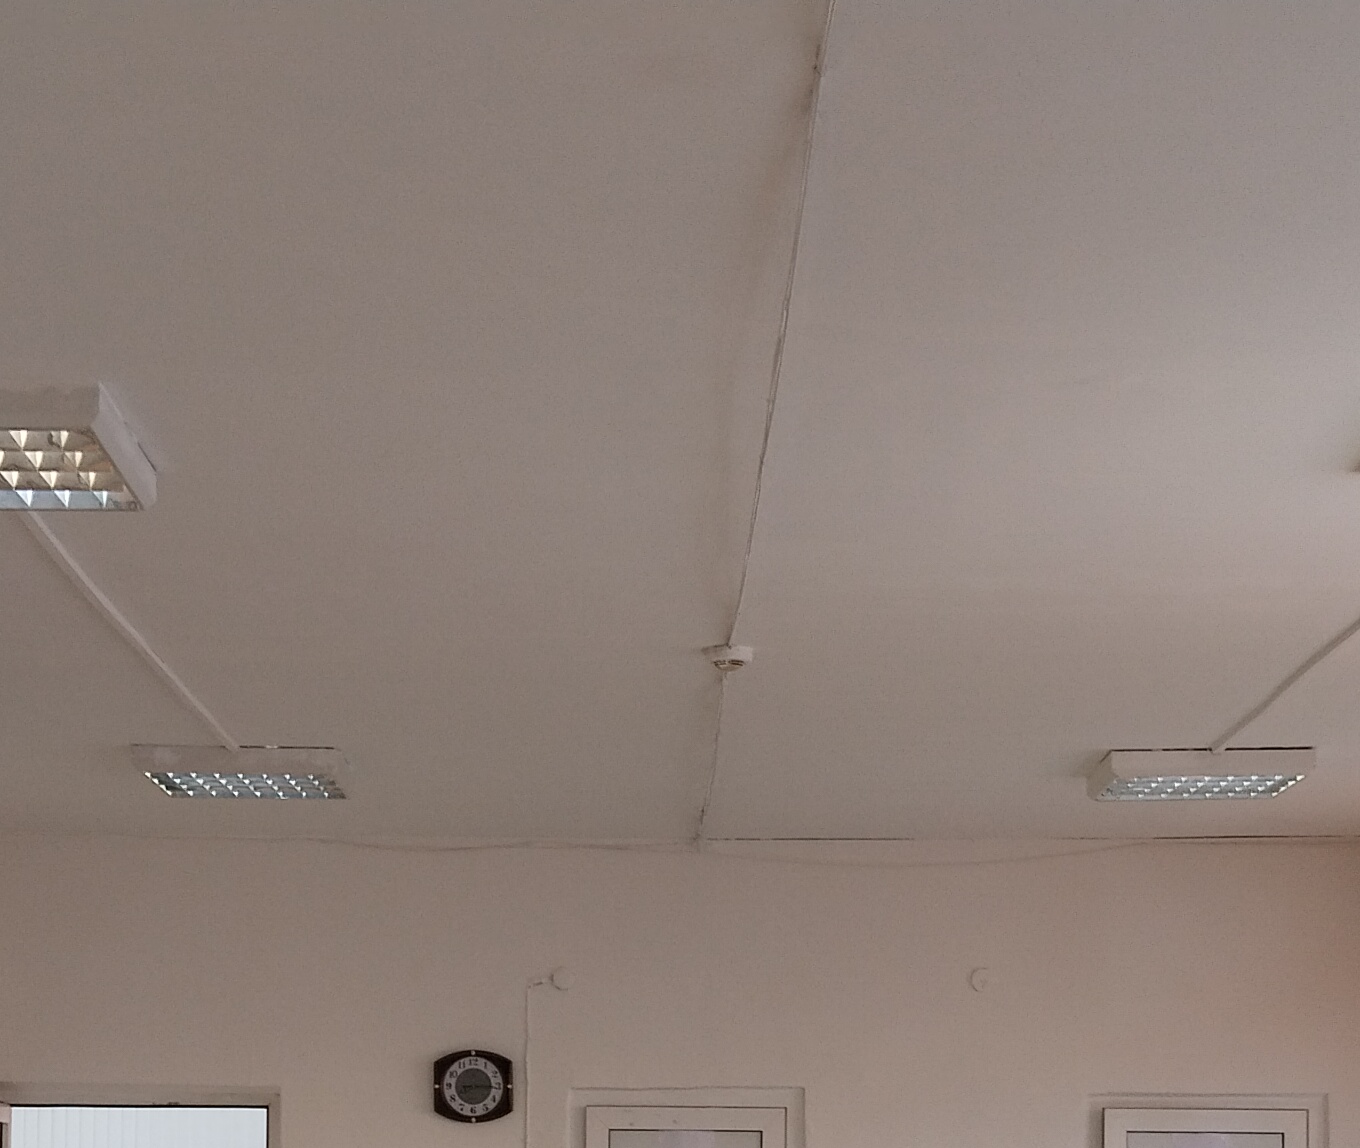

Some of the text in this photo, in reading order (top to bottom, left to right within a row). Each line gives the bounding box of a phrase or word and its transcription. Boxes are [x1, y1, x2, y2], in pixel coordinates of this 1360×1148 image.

[459, 1061, 466, 1069] 11
[468, 1058, 478, 1066] 12
[446, 1082, 452, 1090] 9
[449, 1094, 456, 1103] 8
[459, 1103, 465, 1112] 7
[470, 1106, 477, 1114] 6
[482, 1104, 489, 1112] 5
